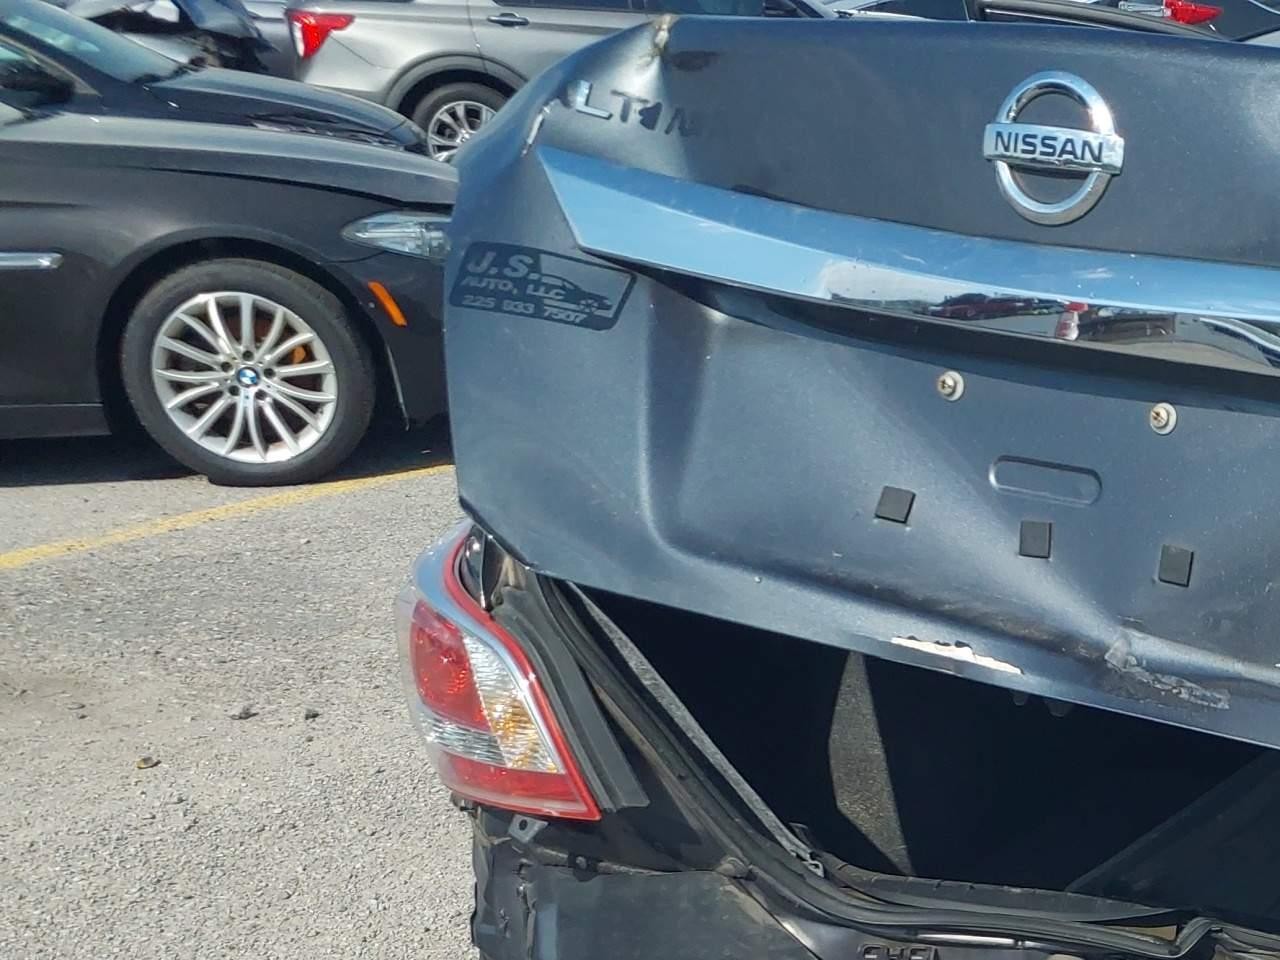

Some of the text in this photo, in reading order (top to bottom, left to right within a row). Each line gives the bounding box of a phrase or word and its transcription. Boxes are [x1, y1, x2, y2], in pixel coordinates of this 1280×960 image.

[994, 130, 1104, 163] NISSAN
[460, 276, 567, 300] AUTO, LLC
[462, 295, 495, 308] 225
[544, 306, 588, 323] 7507
